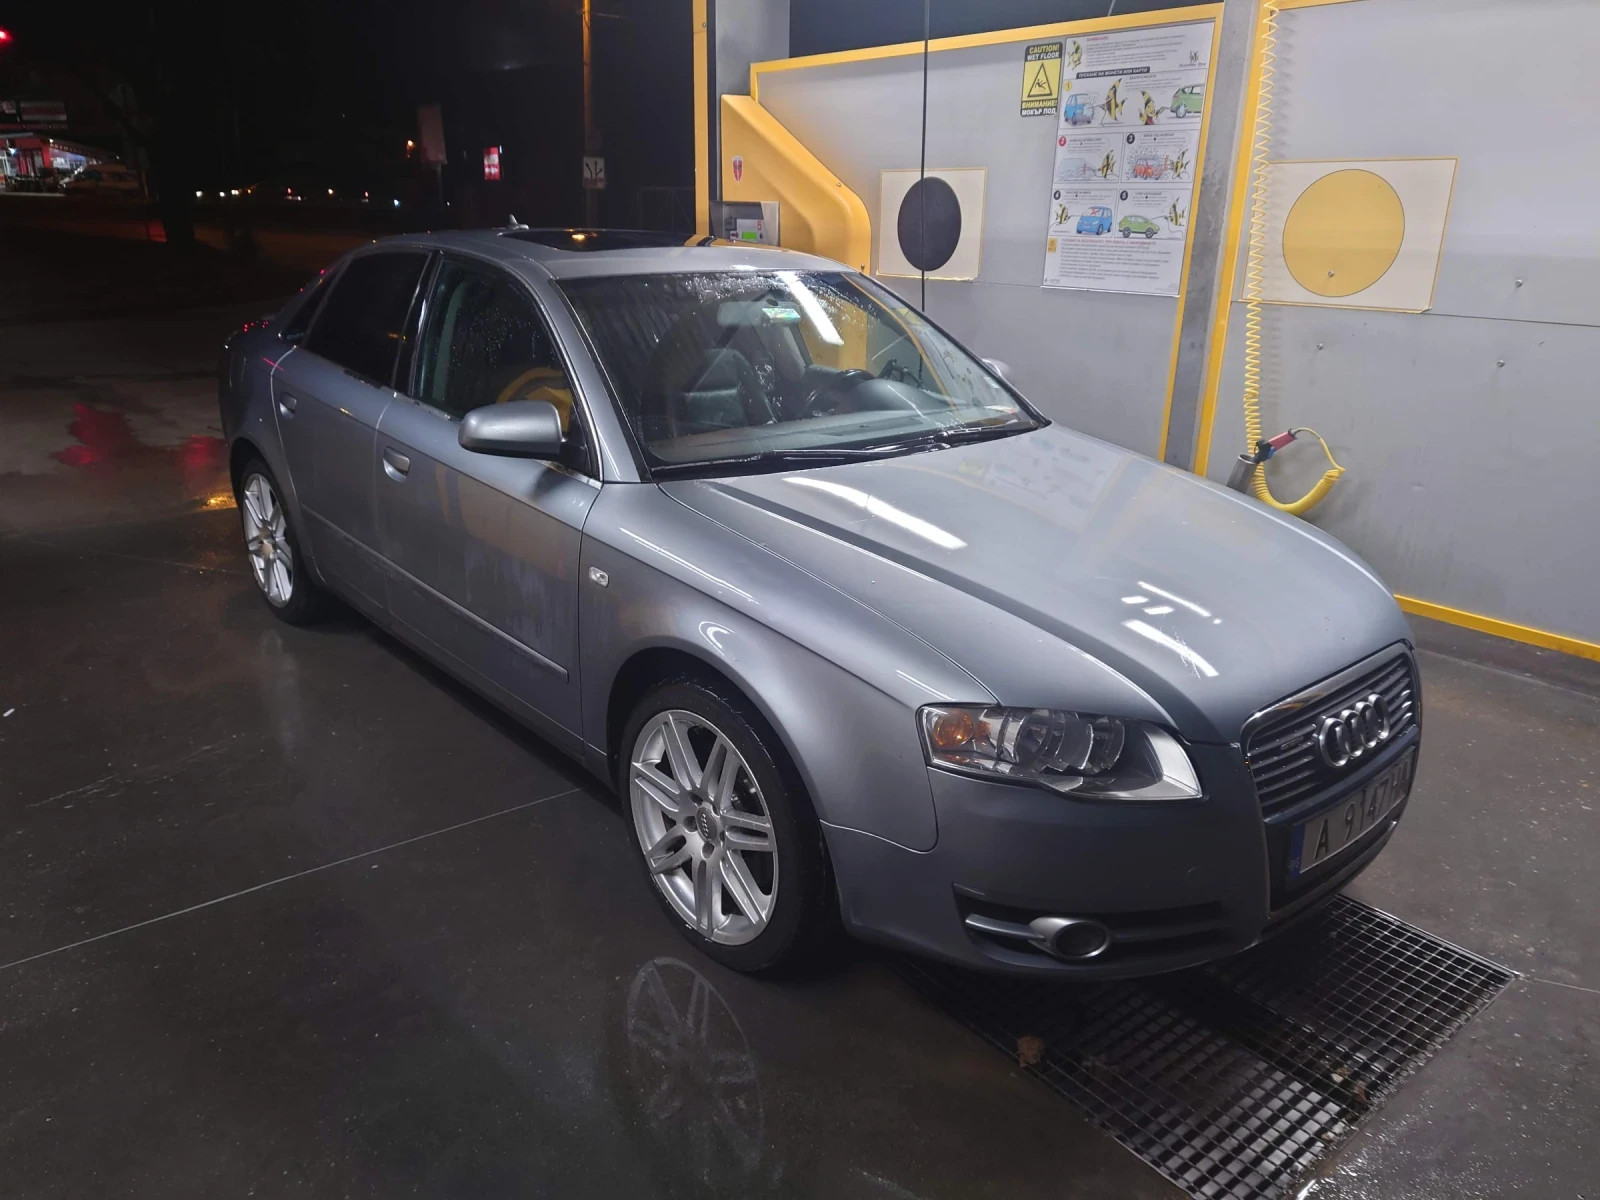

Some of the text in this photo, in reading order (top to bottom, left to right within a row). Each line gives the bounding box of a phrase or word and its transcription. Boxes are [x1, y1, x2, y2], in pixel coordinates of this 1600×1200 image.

[1029, 44, 1060, 54] CAUTION!
[1027, 51, 1060, 61] WET FLOOR
[1021, 99, 1058, 109] ВНИМАНИЕ!
[1021, 107, 1057, 116] МОКЪР ПОД
[1313, 818, 1329, 860] A
[1344, 777, 1390, 842] 9147
